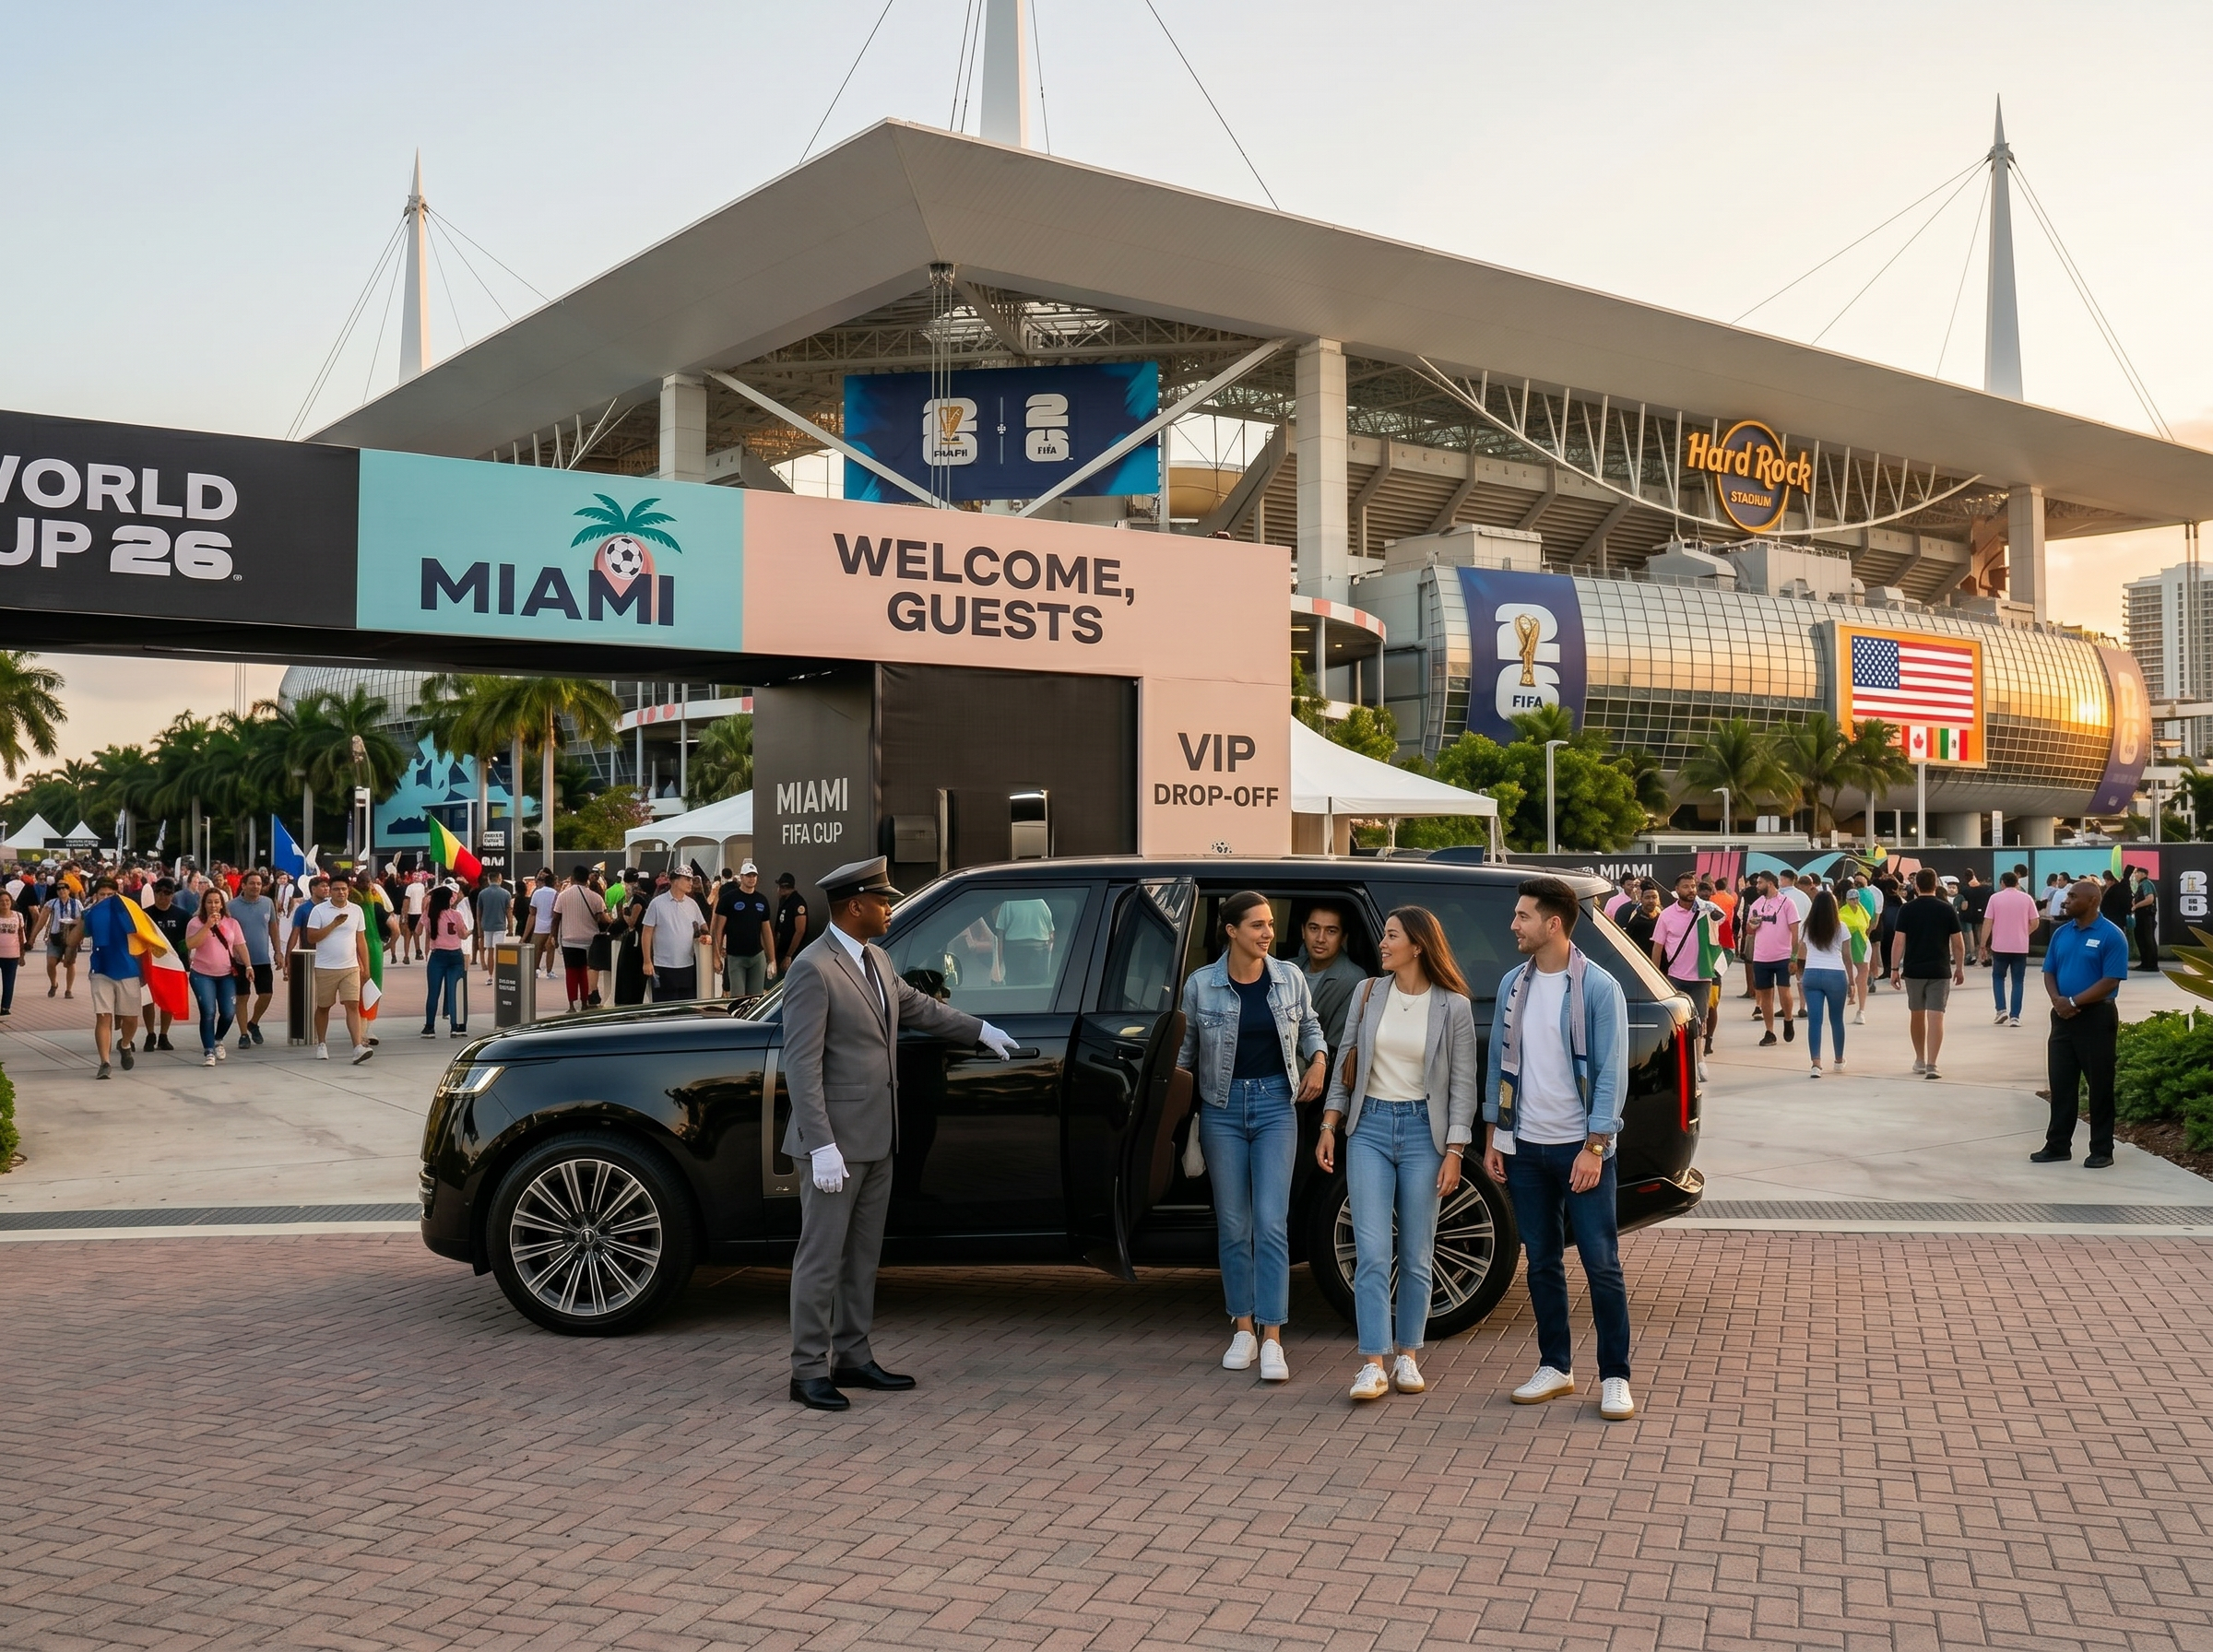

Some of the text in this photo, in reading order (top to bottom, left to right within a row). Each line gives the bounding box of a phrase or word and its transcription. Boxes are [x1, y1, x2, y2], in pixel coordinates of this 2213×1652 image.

[1688, 432, 1812, 494] Hard Rock
[1731, 490, 1772, 507] STADIUM
[110, 525, 233, 580] 26
[833, 533, 1135, 606] WELCOME,
[420, 557, 674, 626] MIAMI
[887, 591, 1103, 644] GUESTS
[1512, 695, 1544, 708] FIFA
[1178, 732, 1255, 773] VIP
[777, 777, 847, 815] MIAMI
[1154, 784, 1279, 807] DROP-OFF
[782, 821, 843, 844] FIFA CUP
[1600, 864, 1652, 879] MIAMI
